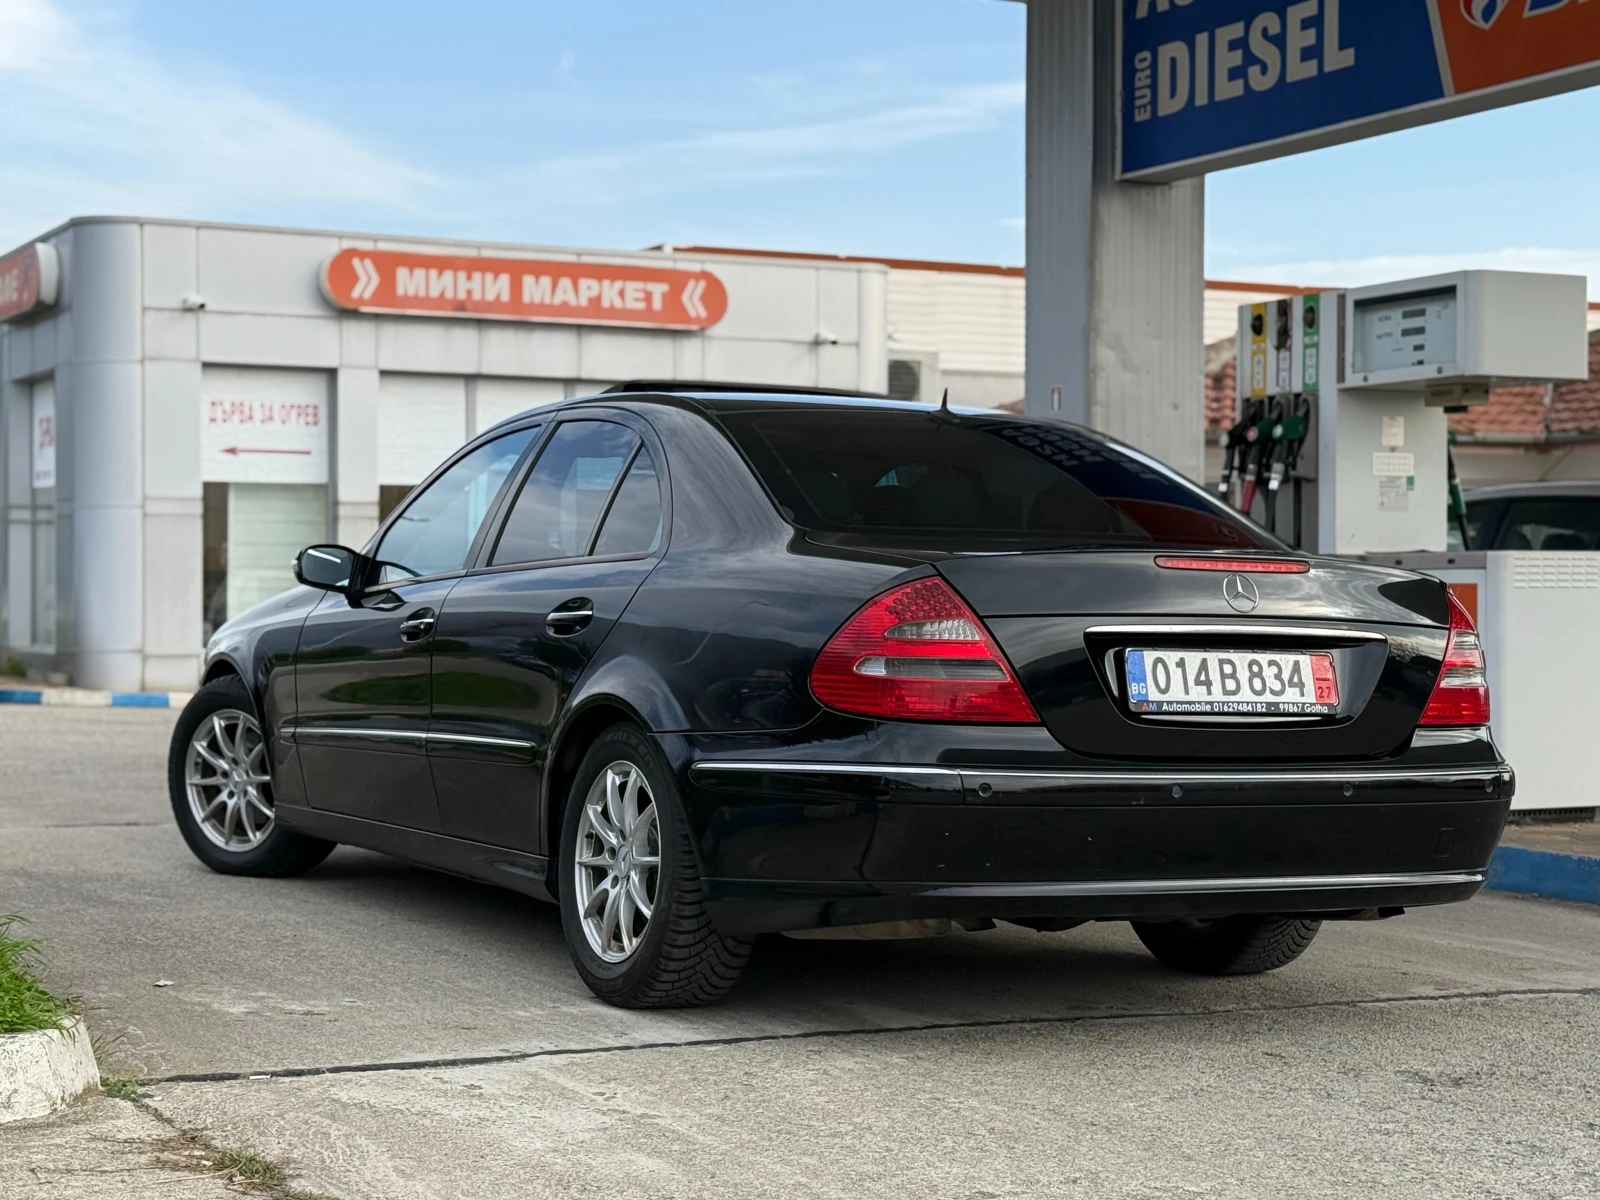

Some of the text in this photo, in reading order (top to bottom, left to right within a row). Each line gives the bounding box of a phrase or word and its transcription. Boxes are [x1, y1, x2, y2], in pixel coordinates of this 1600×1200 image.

[1134, 0, 1356, 123] EURO DIESEL
[396, 266, 670, 312] МИНИ МАРКЕТ
[1131, 683, 1146, 694] BG
[1318, 686, 1331, 698] 27
[1142, 702, 1157, 711] AM
[1162, 702, 1211, 711] Automobile
[1304, 704, 1328, 713] Gotha
